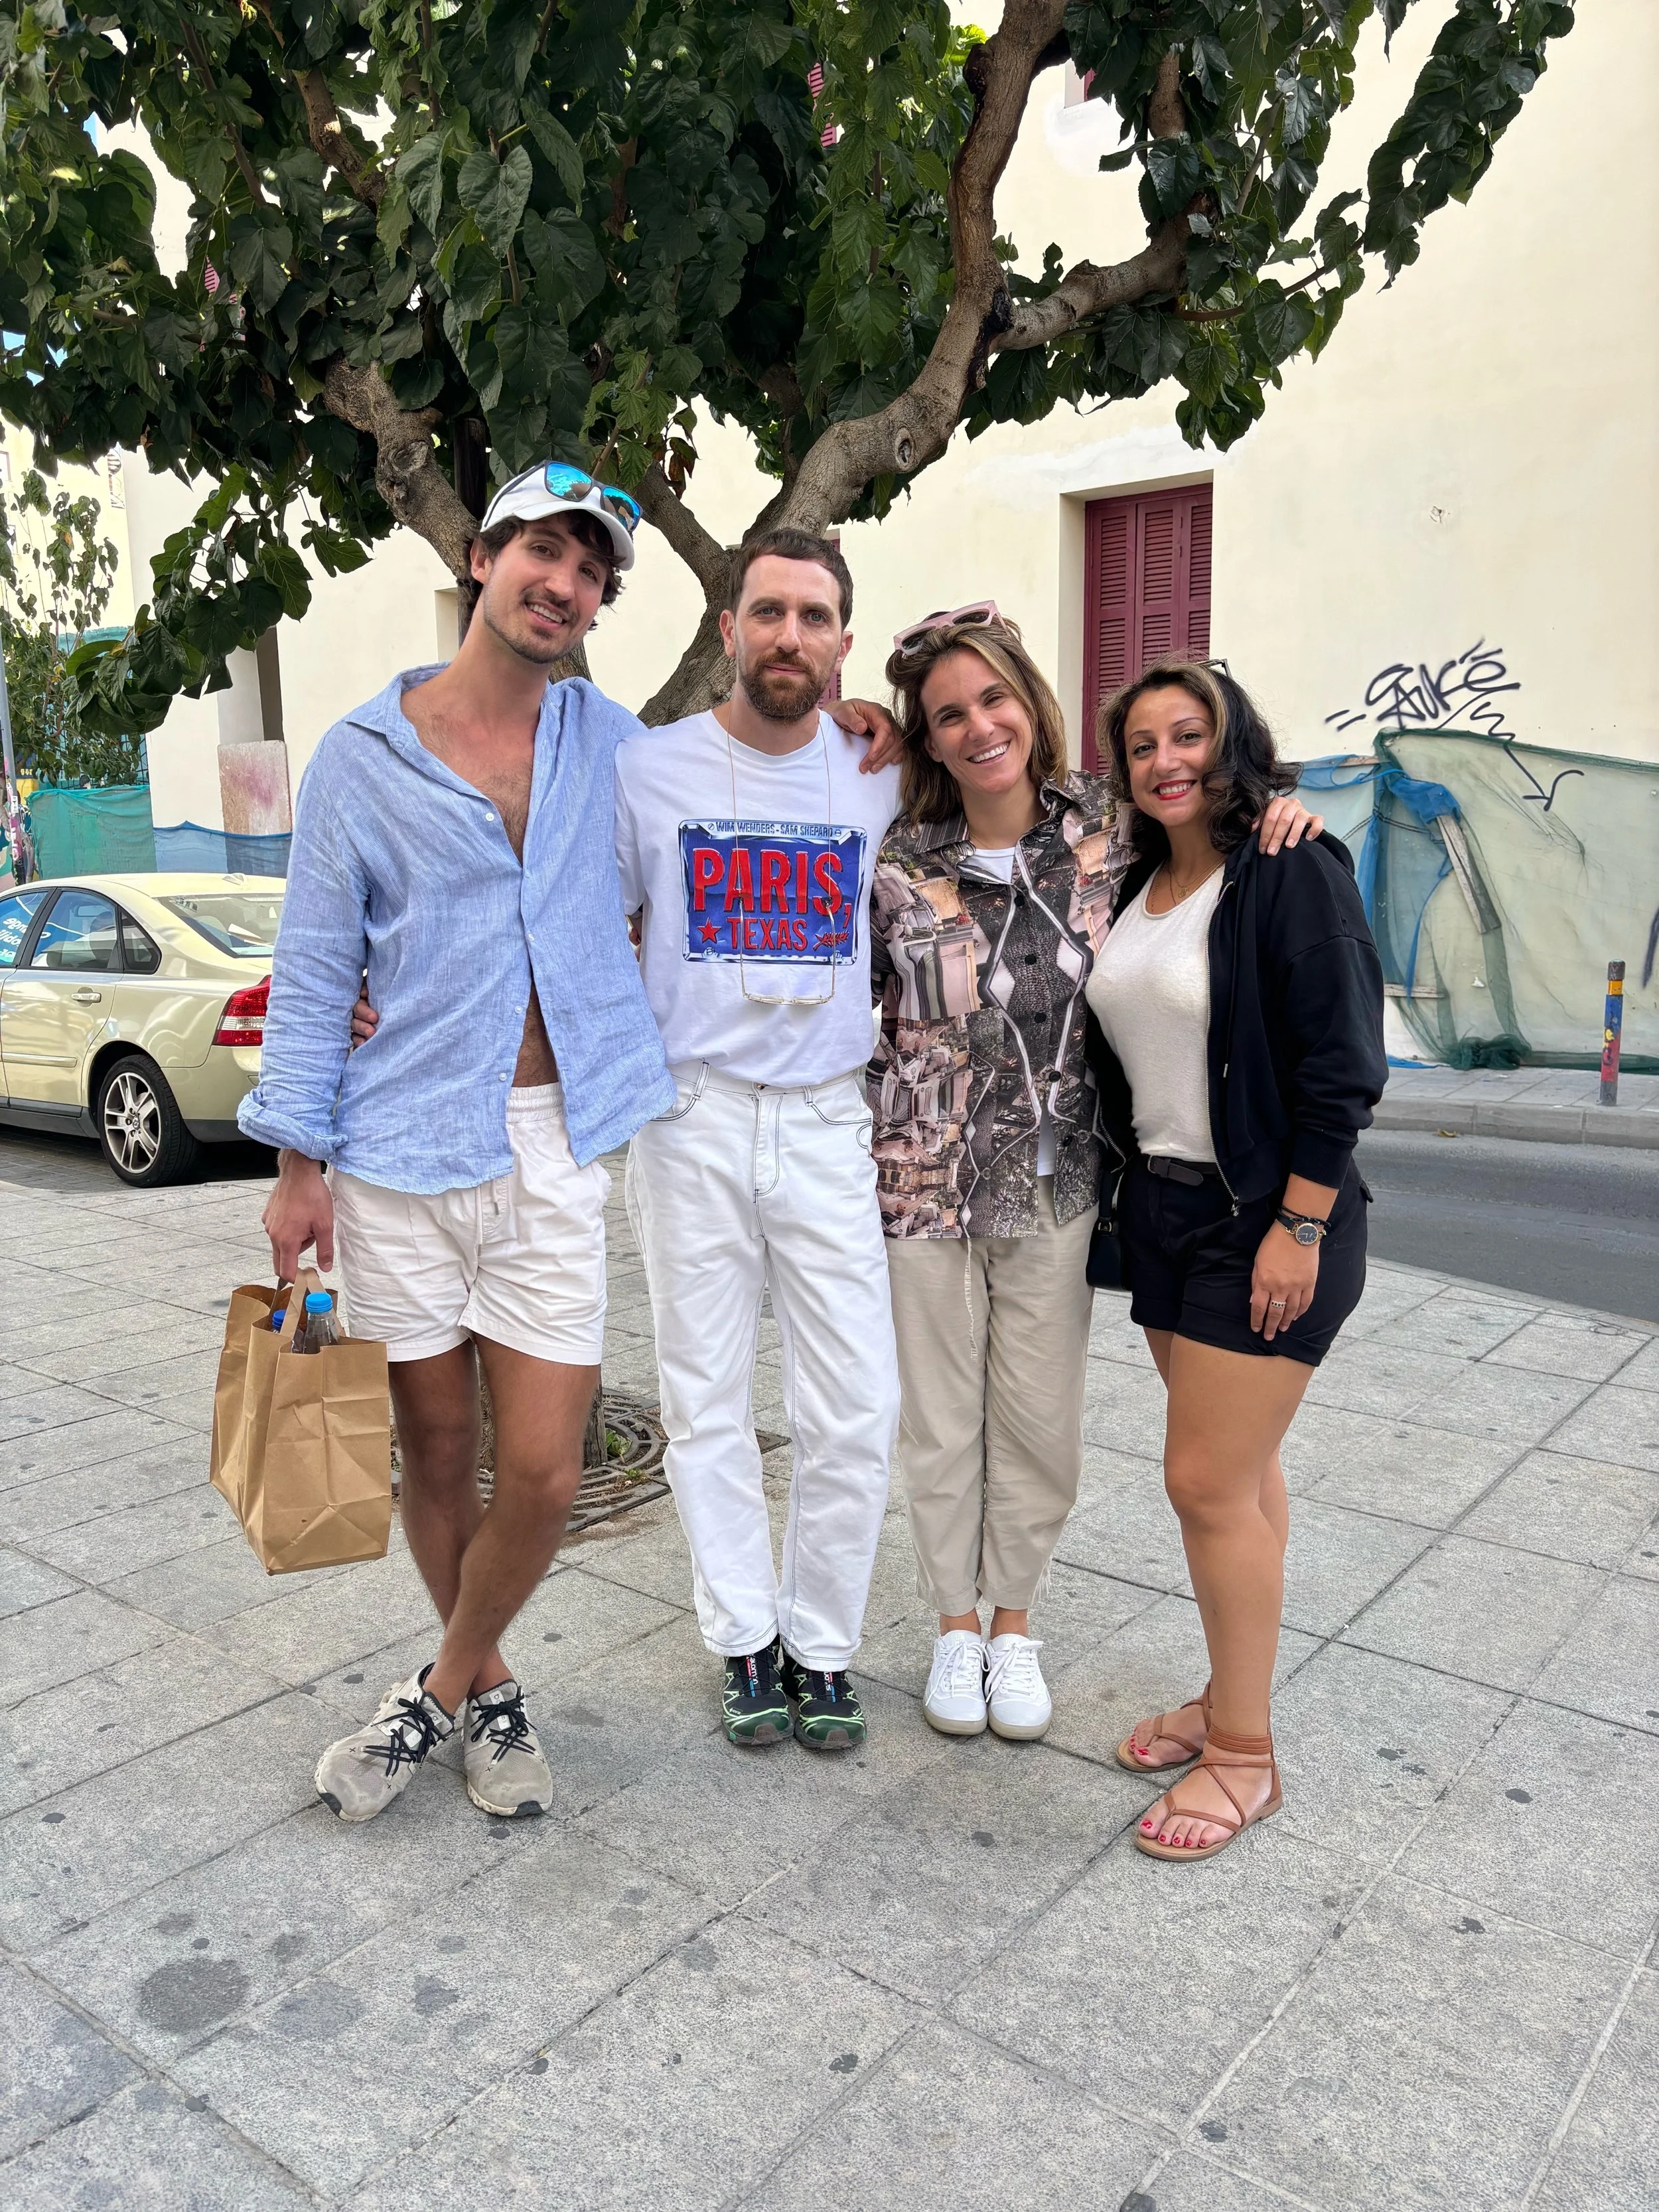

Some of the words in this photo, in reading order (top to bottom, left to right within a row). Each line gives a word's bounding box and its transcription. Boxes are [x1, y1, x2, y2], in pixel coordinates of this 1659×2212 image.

[715, 822, 735, 832] WIM
[737, 822, 775, 834] WENDERS
[780, 824, 798, 836] SAM
[800, 825, 833, 838] SHEPARD
[693, 848, 852, 929] PARIS,
[727, 916, 808, 951] TEXAS
